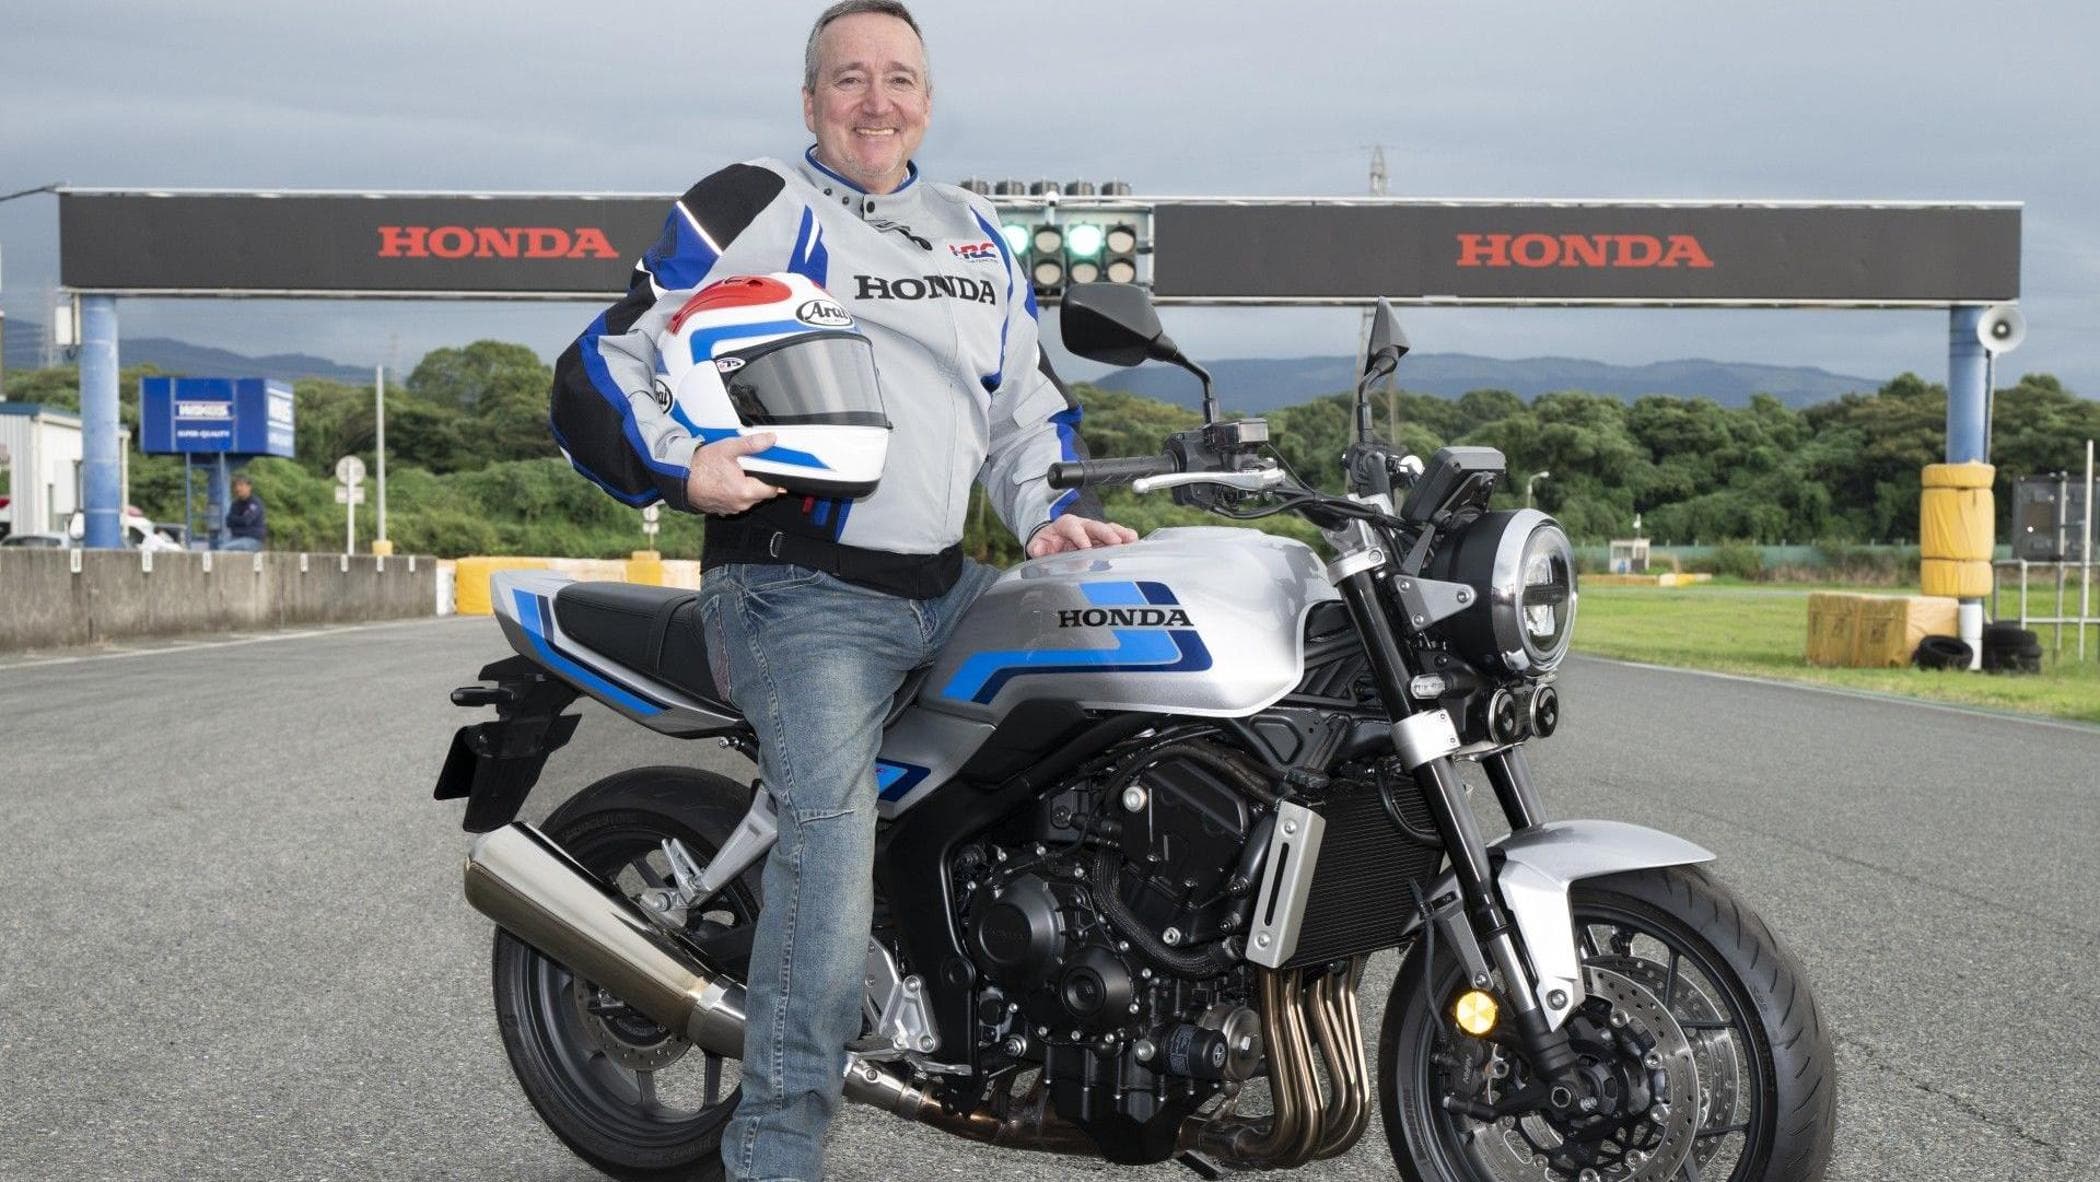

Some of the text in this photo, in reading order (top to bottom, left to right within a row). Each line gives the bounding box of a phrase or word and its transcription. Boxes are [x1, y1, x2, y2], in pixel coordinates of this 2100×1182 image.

[377, 226, 620, 258] HONDA
[949, 242, 996, 259] HRC
[1456, 233, 1714, 267] HONDA
[853, 275, 996, 306] HONDA
[804, 301, 849, 320] Arai
[1058, 608, 1194, 628] HONDA
